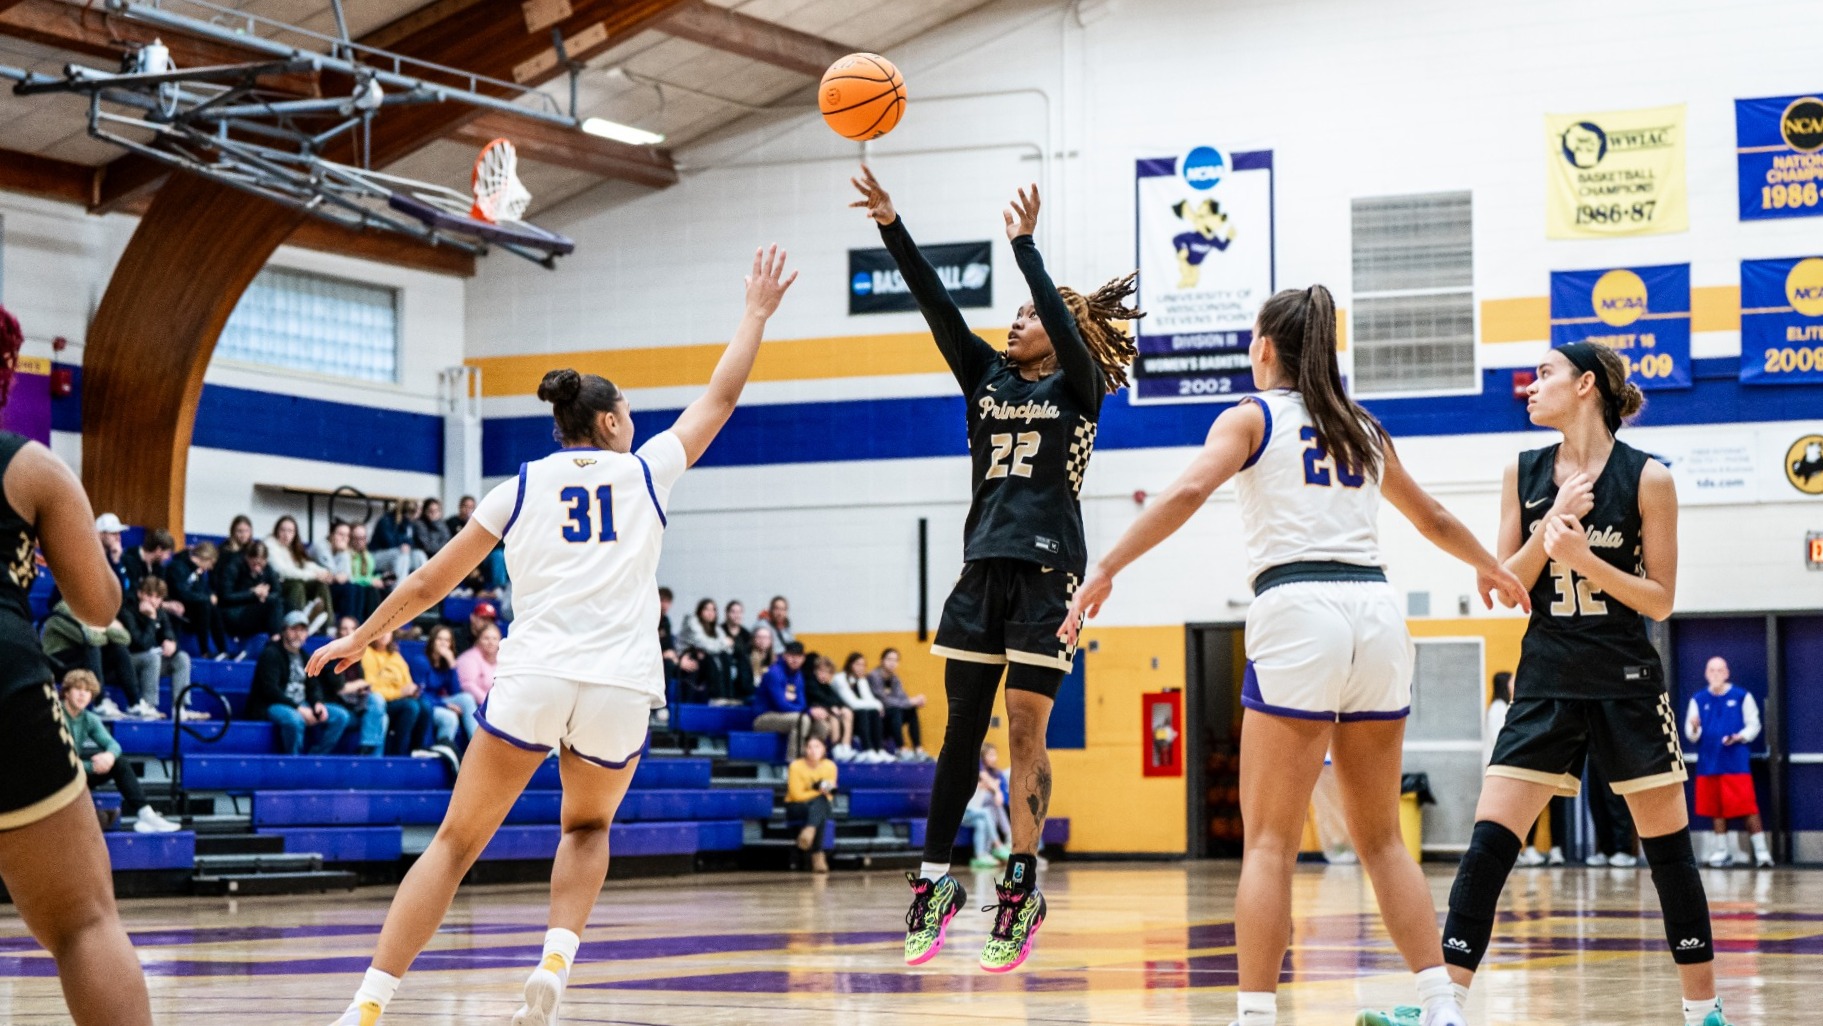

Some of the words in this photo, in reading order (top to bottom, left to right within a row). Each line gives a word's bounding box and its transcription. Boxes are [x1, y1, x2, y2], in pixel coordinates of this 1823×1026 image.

[1609, 129, 1669, 147] WWIAC
[1578, 169, 1656, 183] BASKETBALL
[1579, 182, 1655, 197] CHAMPIONS
[1156, 290, 1232, 303] UNIVERSITY
[1236, 288, 1252, 299] OF
[1602, 296, 1643, 310] NCAA
[1166, 302, 1242, 314] WISCONSIN
[1155, 314, 1212, 326] STEVENS
[1216, 311, 1254, 322] POINT
[1171, 334, 1225, 350] DIVISION
[1640, 332, 1656, 348] 16
[1144, 356, 1198, 373] WOMEN'S
[1179, 377, 1232, 395] 2002
[979, 395, 1060, 424] Principia
[985, 430, 1042, 480] 22
[559, 483, 618, 544] 31
[1550, 561, 1608, 616] 32
